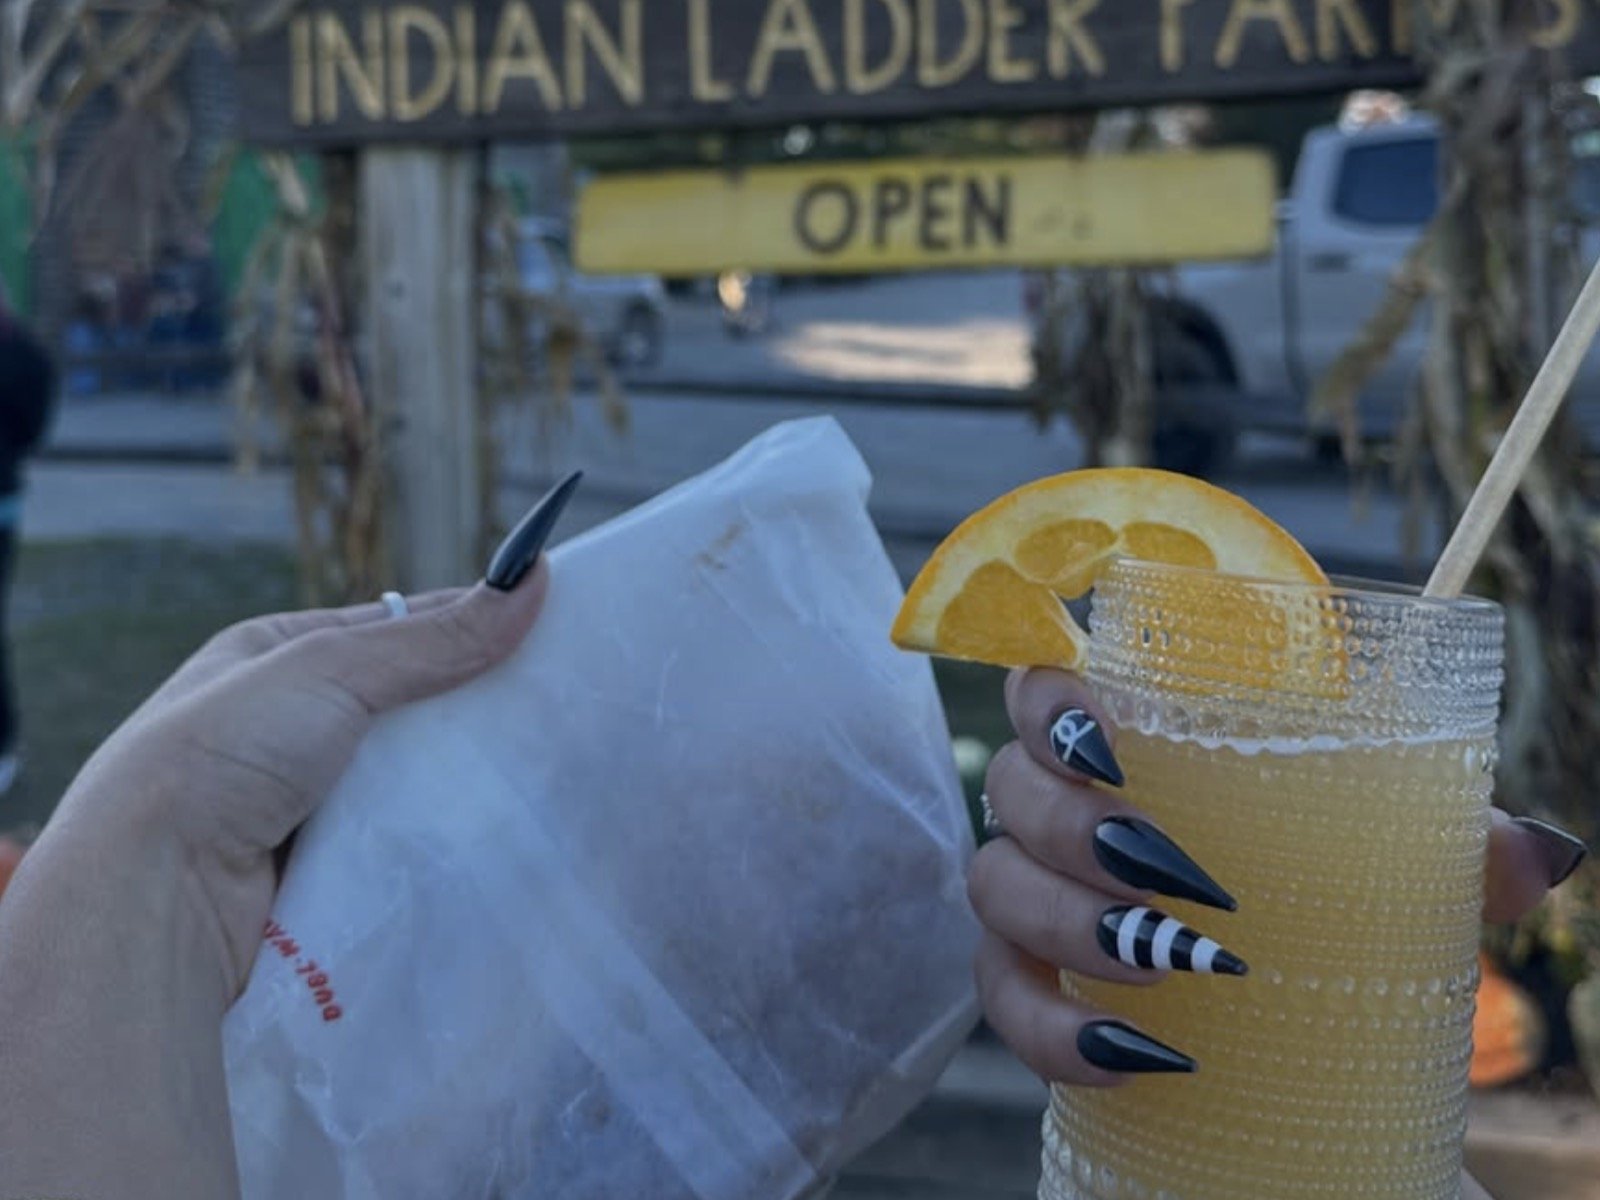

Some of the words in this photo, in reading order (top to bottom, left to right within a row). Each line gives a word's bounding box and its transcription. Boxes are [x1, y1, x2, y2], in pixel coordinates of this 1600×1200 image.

[290, 0, 644, 124] INDIAN
[690, 0, 1104, 100] LADDER
[794, 174, 1012, 254] OPEN
